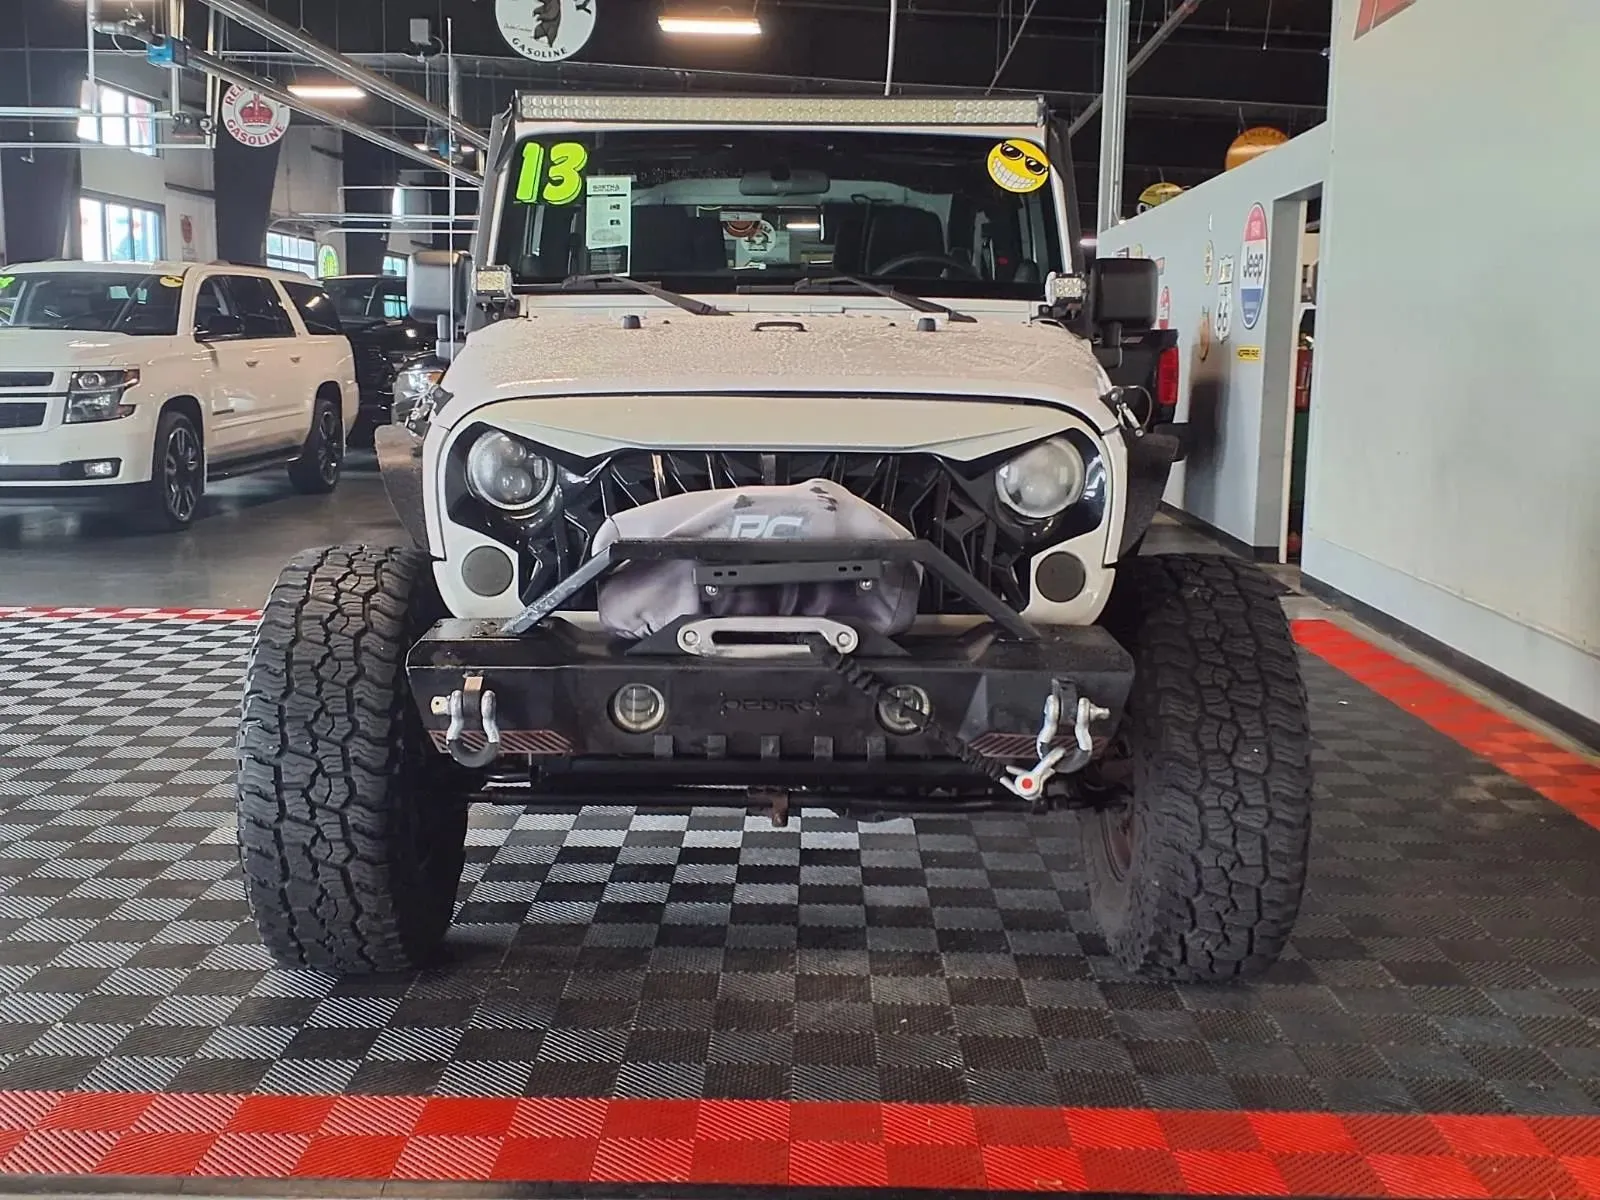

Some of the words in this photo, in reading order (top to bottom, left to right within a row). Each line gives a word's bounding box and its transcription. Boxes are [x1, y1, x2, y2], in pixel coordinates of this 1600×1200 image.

[512, 38, 568, 58] GASOLINE
[227, 119, 286, 145] GASOLINE
[516, 142, 588, 206] 13
[1243, 246, 1264, 285] Jeep
